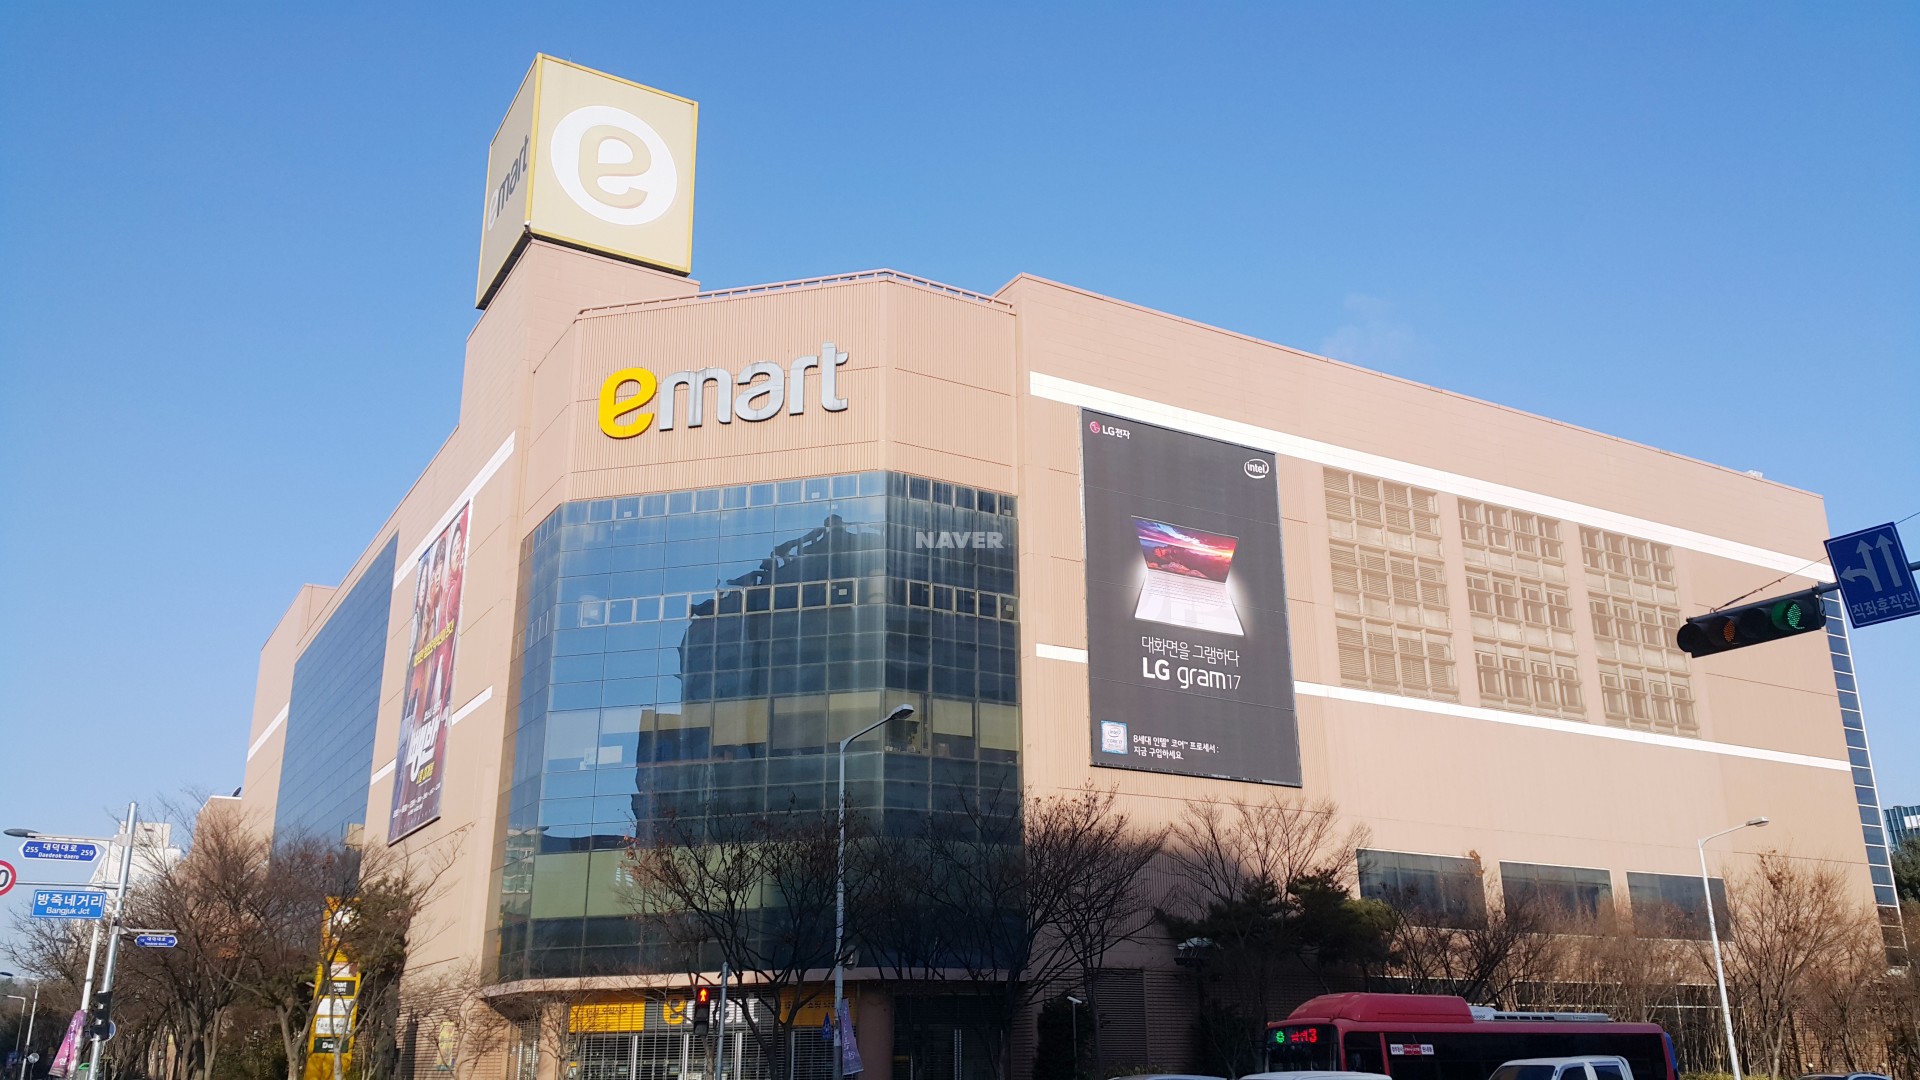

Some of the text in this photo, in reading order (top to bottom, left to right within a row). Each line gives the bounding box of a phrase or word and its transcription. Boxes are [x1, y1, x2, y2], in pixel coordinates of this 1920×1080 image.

[578, 124, 651, 209] e
[488, 134, 529, 231] emart
[598, 341, 849, 439] emart
[1102, 425, 1130, 440] LG전자
[1852, 591, 1916, 619] 직좌후직진
[1141, 636, 1240, 667] 대화면을 그램하다
[1143, 657, 1170, 680] LG
[1133, 735, 1151, 744] 8세대
[1134, 746, 1147, 756] 지금
[43, 843, 79, 852] 대덕대로
[80, 849, 94, 857] 259
[0, 869, 9, 887] 0
[37, 893, 103, 908] 방죽네거리
[46, 907, 77, 916] Bangjuk
